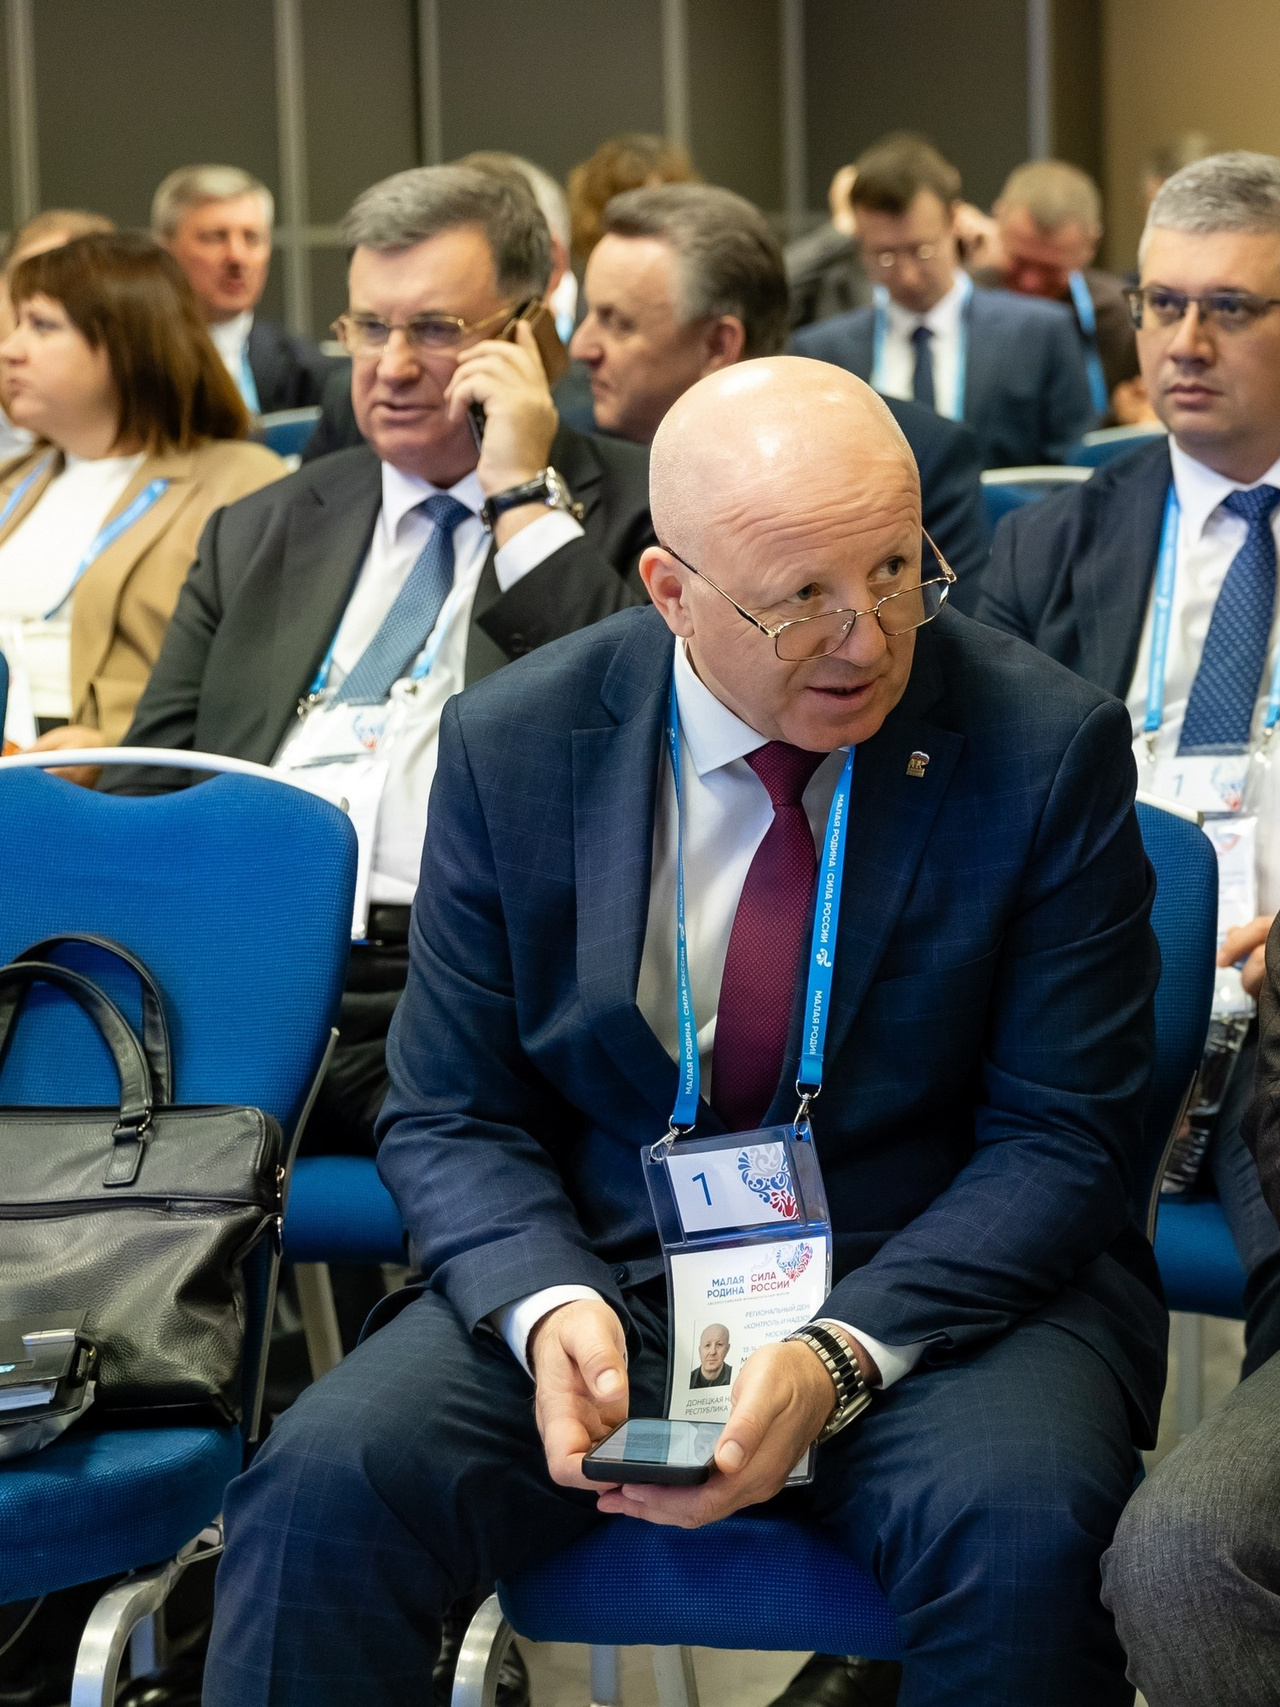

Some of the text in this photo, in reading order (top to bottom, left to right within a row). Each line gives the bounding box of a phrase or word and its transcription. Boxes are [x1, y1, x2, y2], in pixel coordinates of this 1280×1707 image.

[820, 794, 844, 943] МАЛАЯ РОДИНА СИЛА РОССИИ
[812, 990, 822, 1024] МАЛАЯ
[685, 1021, 693, 1060] РОДИНА
[685, 1062, 695, 1095] МАЛАЯ
[692, 1172, 712, 1206] 1
[707, 1286, 745, 1299] РОДИНА
[750, 1280, 790, 1293] РОССИИ
[712, 1271, 777, 1288] МАЛАЯ СИЛА
[685, 1405, 729, 1416] РЕСПУБЛИКА
[686, 1396, 724, 1407] ДОНЕЦКАЯ
